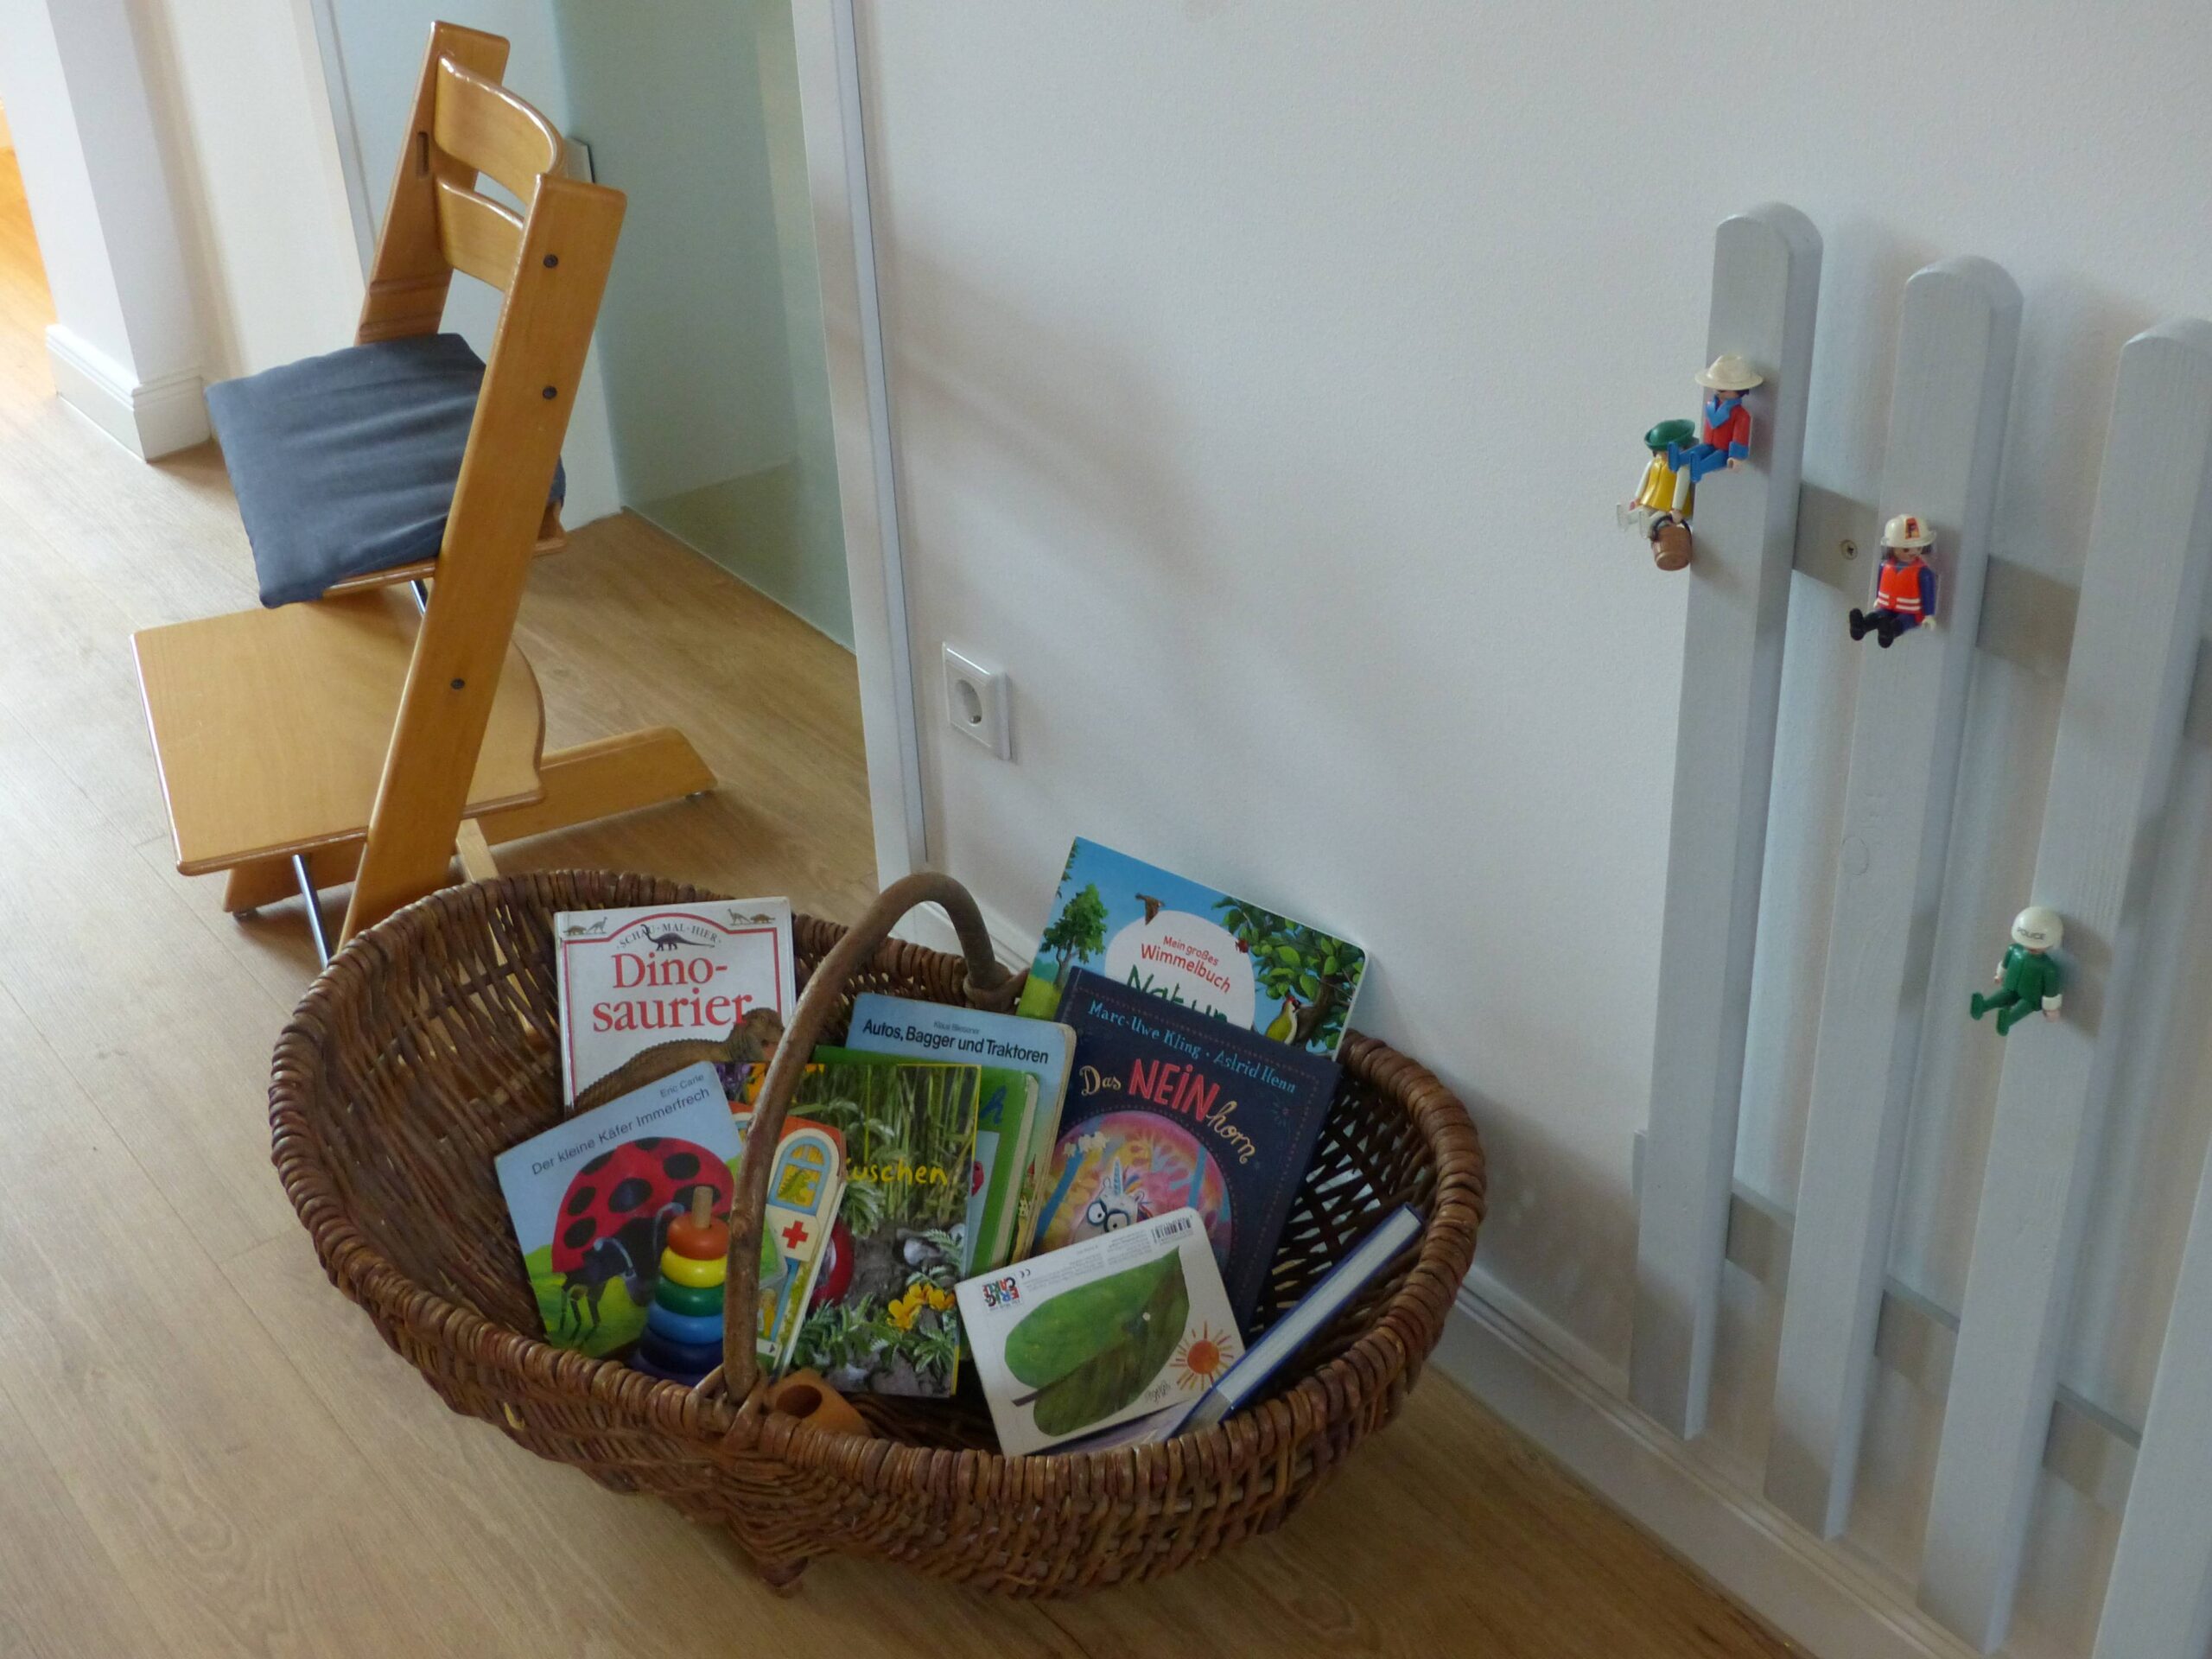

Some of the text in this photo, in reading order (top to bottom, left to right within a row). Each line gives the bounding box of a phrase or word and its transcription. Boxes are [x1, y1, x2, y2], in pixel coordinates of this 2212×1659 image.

[663, 923, 685, 932] MAL
[691, 925, 718, 943] HIER
[1163, 935, 1219, 966] Mein großes
[612, 951, 728, 989] Dino-
[1141, 944, 1230, 994] Wimmelbuch
[593, 988, 753, 1033] saurier
[862, 1019, 1049, 1064] Autos, Bagger und Traktoren
[1088, 1000, 1297, 1094] Marc-Uwe Kling Astrid Henn
[660, 1074, 704, 1098] Eric Carle
[1080, 1065, 1122, 1096] Das
[531, 1087, 710, 1176] Der kleine Käfer Immerfrech
[847, 1156, 949, 1186] uschen
